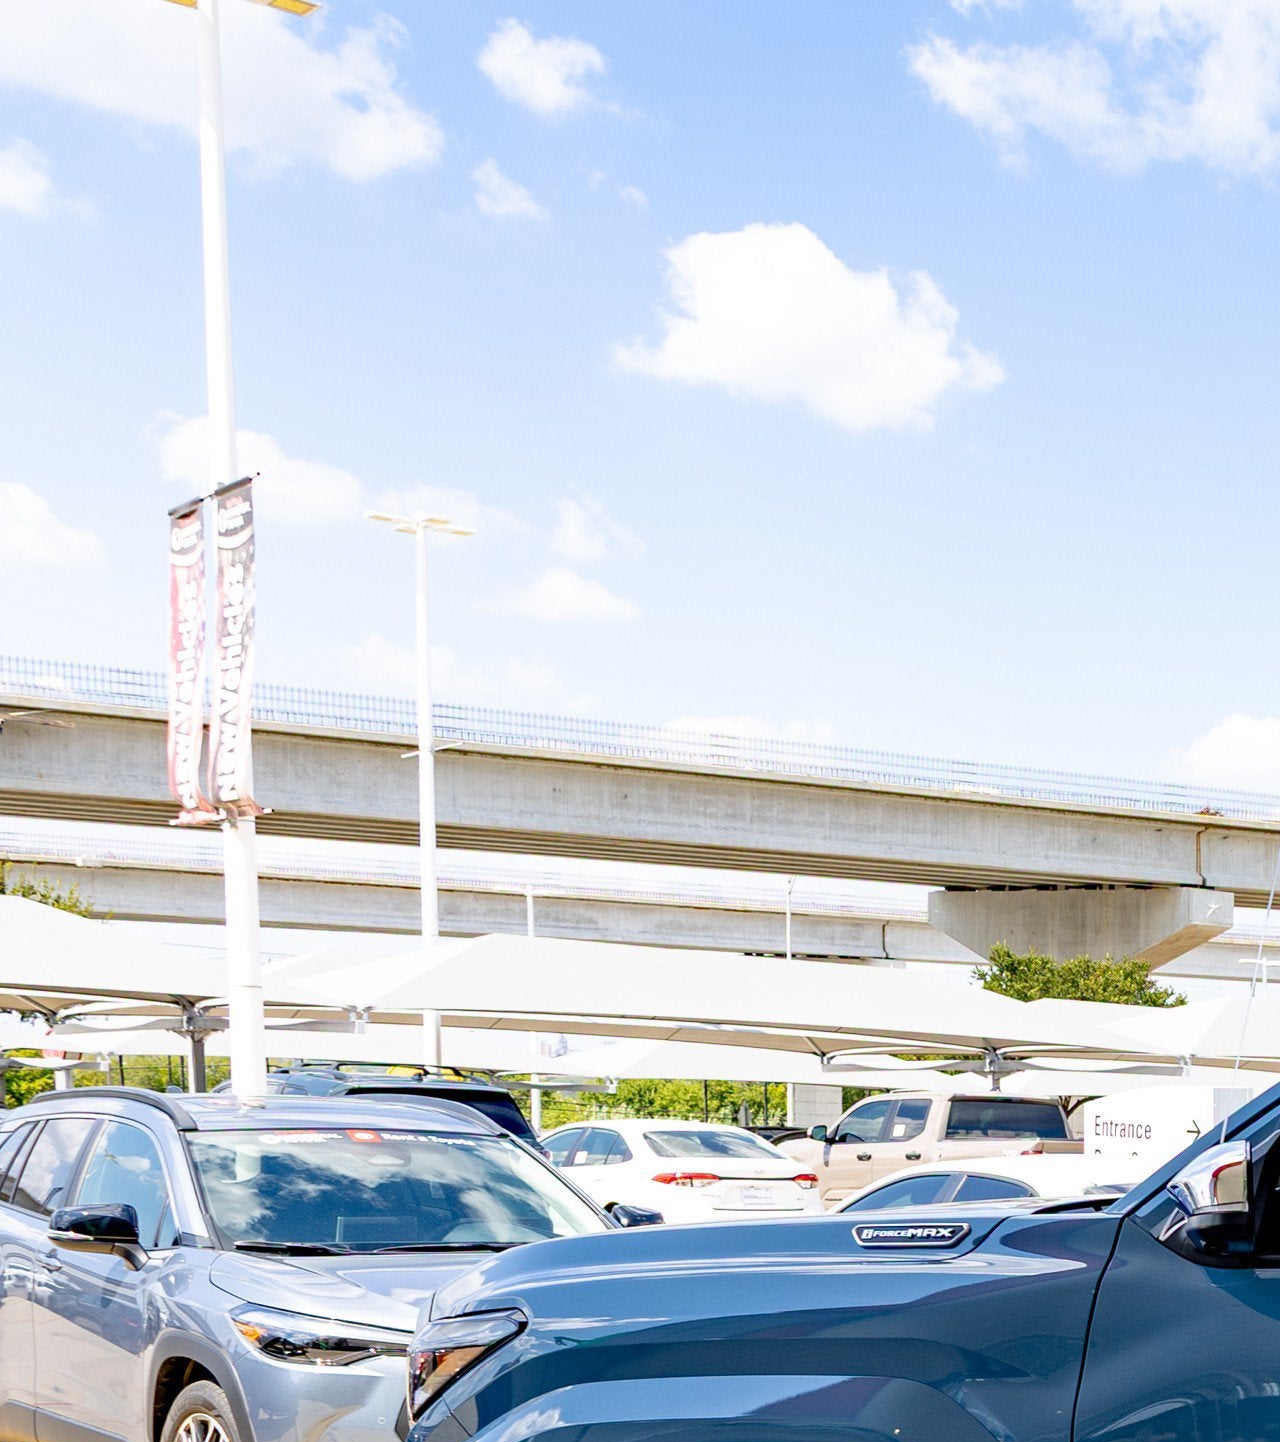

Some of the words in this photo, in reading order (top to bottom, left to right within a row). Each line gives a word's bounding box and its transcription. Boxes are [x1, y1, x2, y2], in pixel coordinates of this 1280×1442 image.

[218, 562, 244, 717] Vehicles
[217, 722, 241, 801] New
[1094, 1115, 1152, 1139] Entrance
